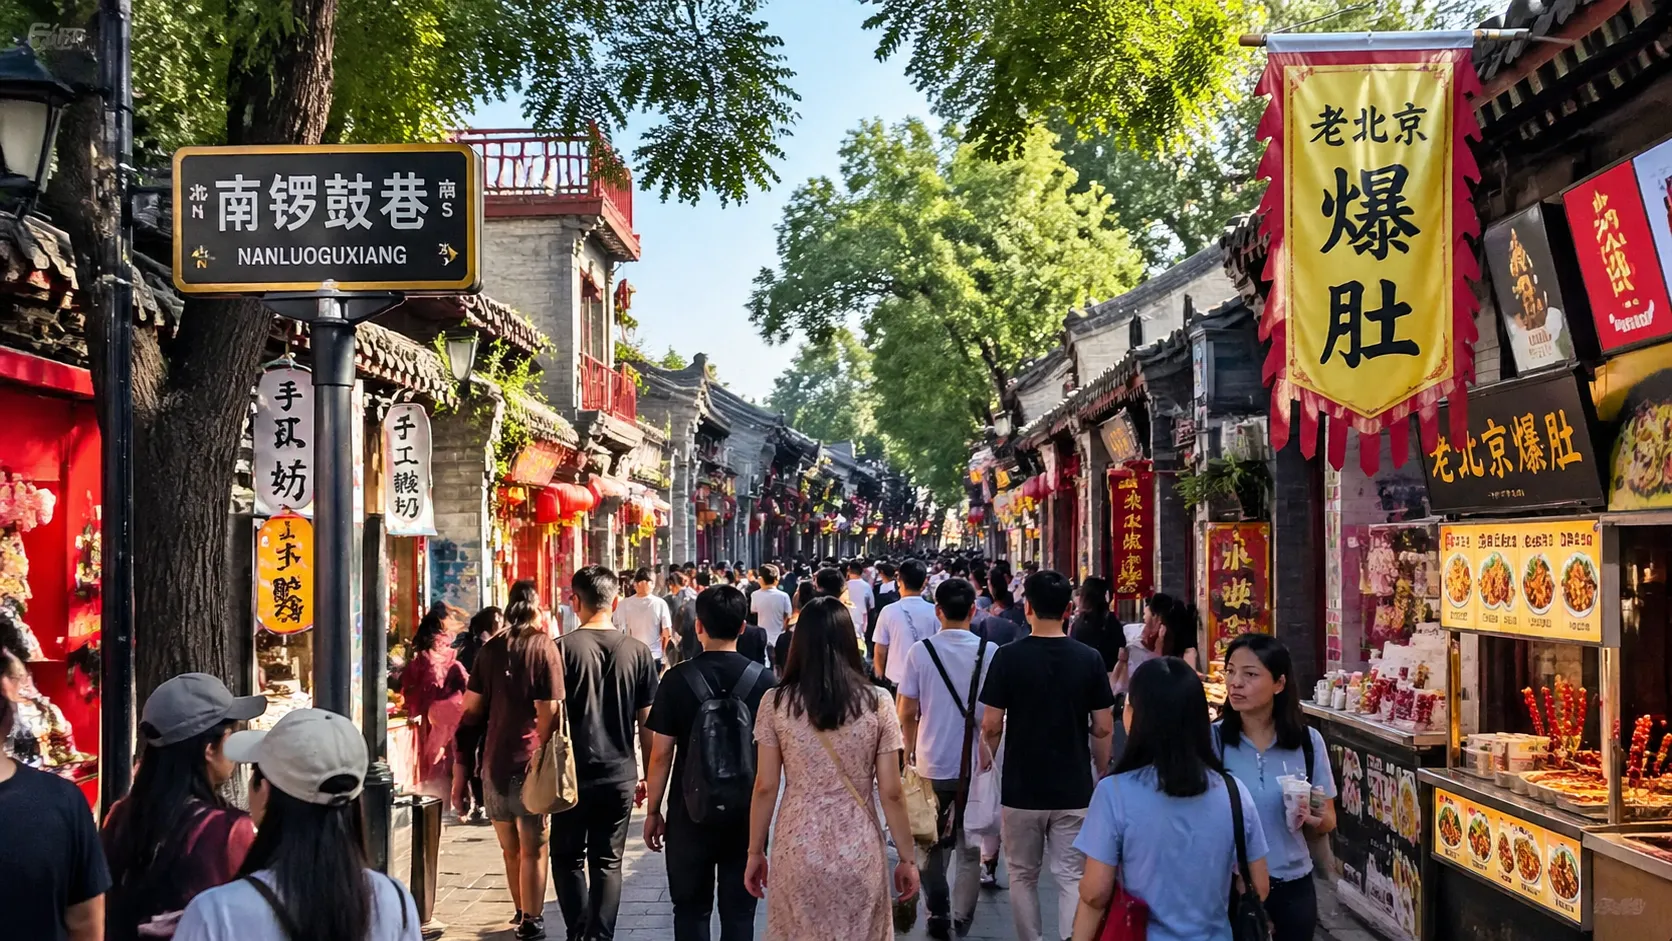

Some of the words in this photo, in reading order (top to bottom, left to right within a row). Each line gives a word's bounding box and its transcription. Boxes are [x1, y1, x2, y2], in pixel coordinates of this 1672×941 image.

[1309, 102, 1428, 147] 老北京
[215, 171, 430, 232] 南锣鼓巷
[441, 202, 454, 218] S
[237, 245, 407, 267] NANLUOGUXIANG
[1319, 164, 1421, 369] 爆肚
[1429, 409, 1583, 483] 老北京爆肚
